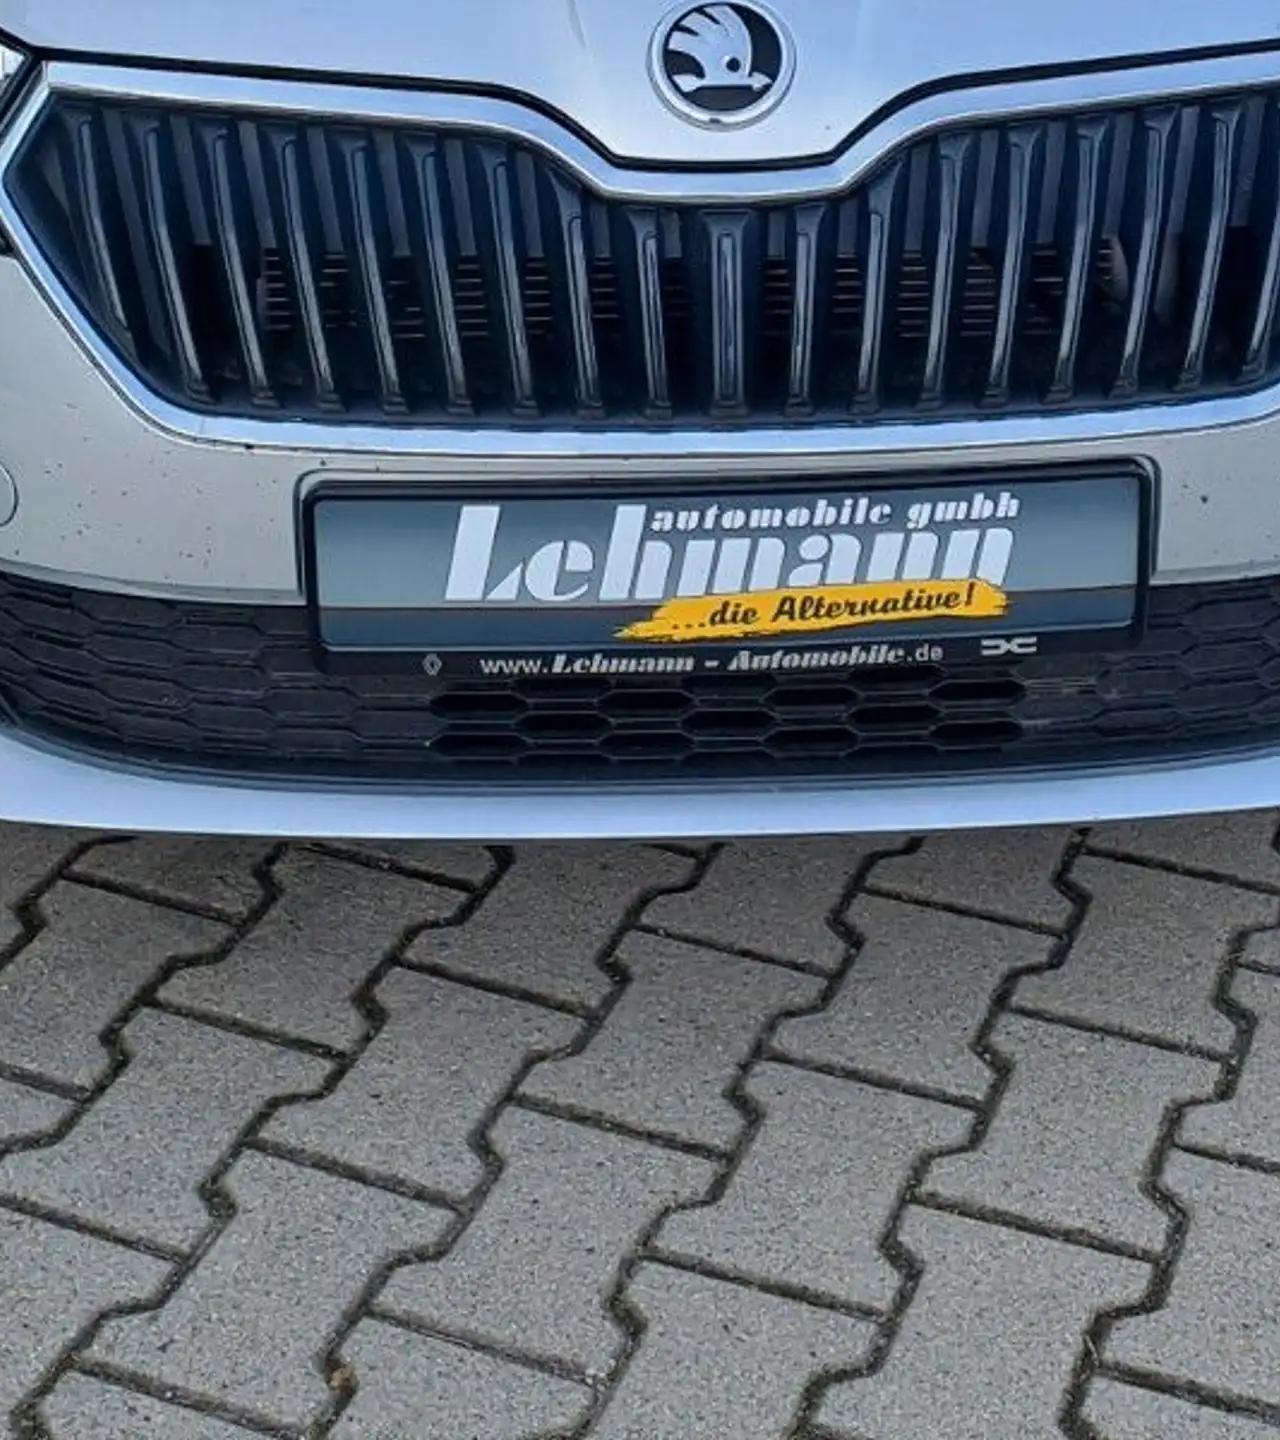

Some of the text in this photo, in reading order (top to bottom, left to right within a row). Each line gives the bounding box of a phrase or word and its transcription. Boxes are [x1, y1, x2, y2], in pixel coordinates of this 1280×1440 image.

[650, 492, 1019, 532] automobile gmbh
[445, 504, 1014, 600] Lehmann
[772, 581, 976, 622] Alternative!
[480, 653, 694, 674] www.Lehmann
[727, 643, 943, 671] Automobile.de
